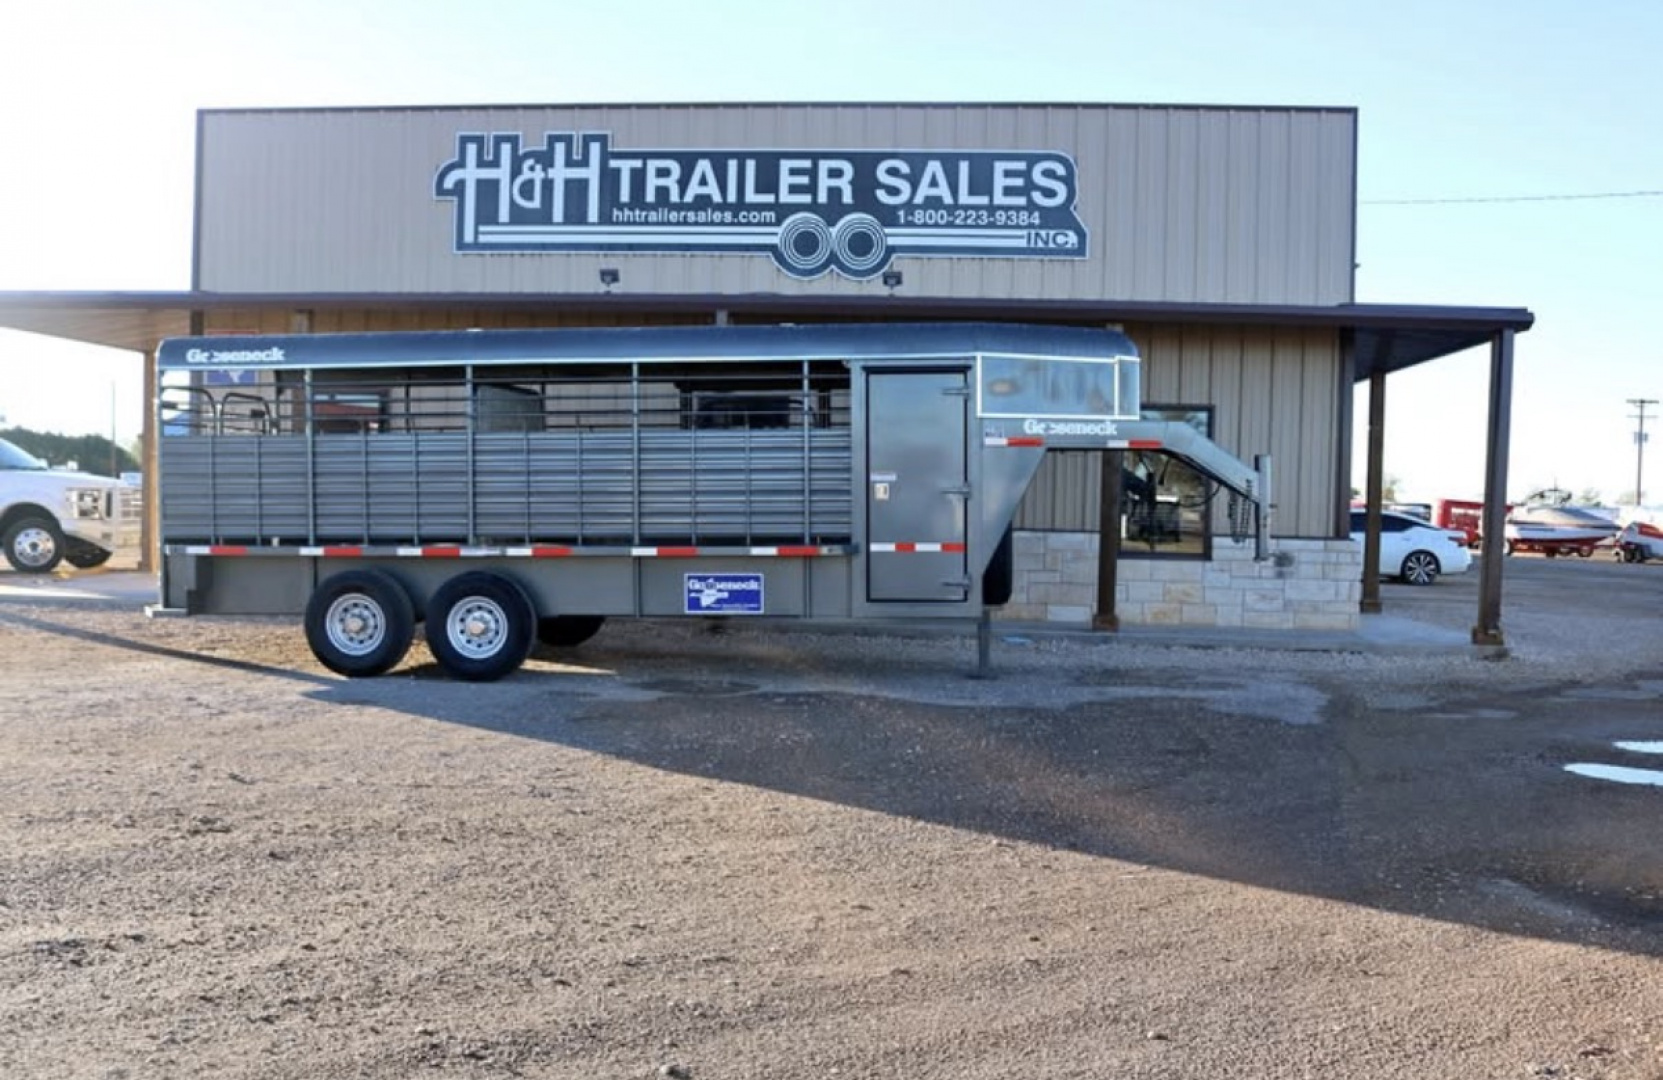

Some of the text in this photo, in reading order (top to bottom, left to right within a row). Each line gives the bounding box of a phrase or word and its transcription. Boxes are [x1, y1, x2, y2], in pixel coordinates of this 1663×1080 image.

[443, 142, 1068, 243] H&H TRAILER SALES
[612, 208, 776, 223] hhtrailersales.com
[897, 210, 1041, 226] 1-800-223-9384
[1026, 231, 1077, 248] INC.
